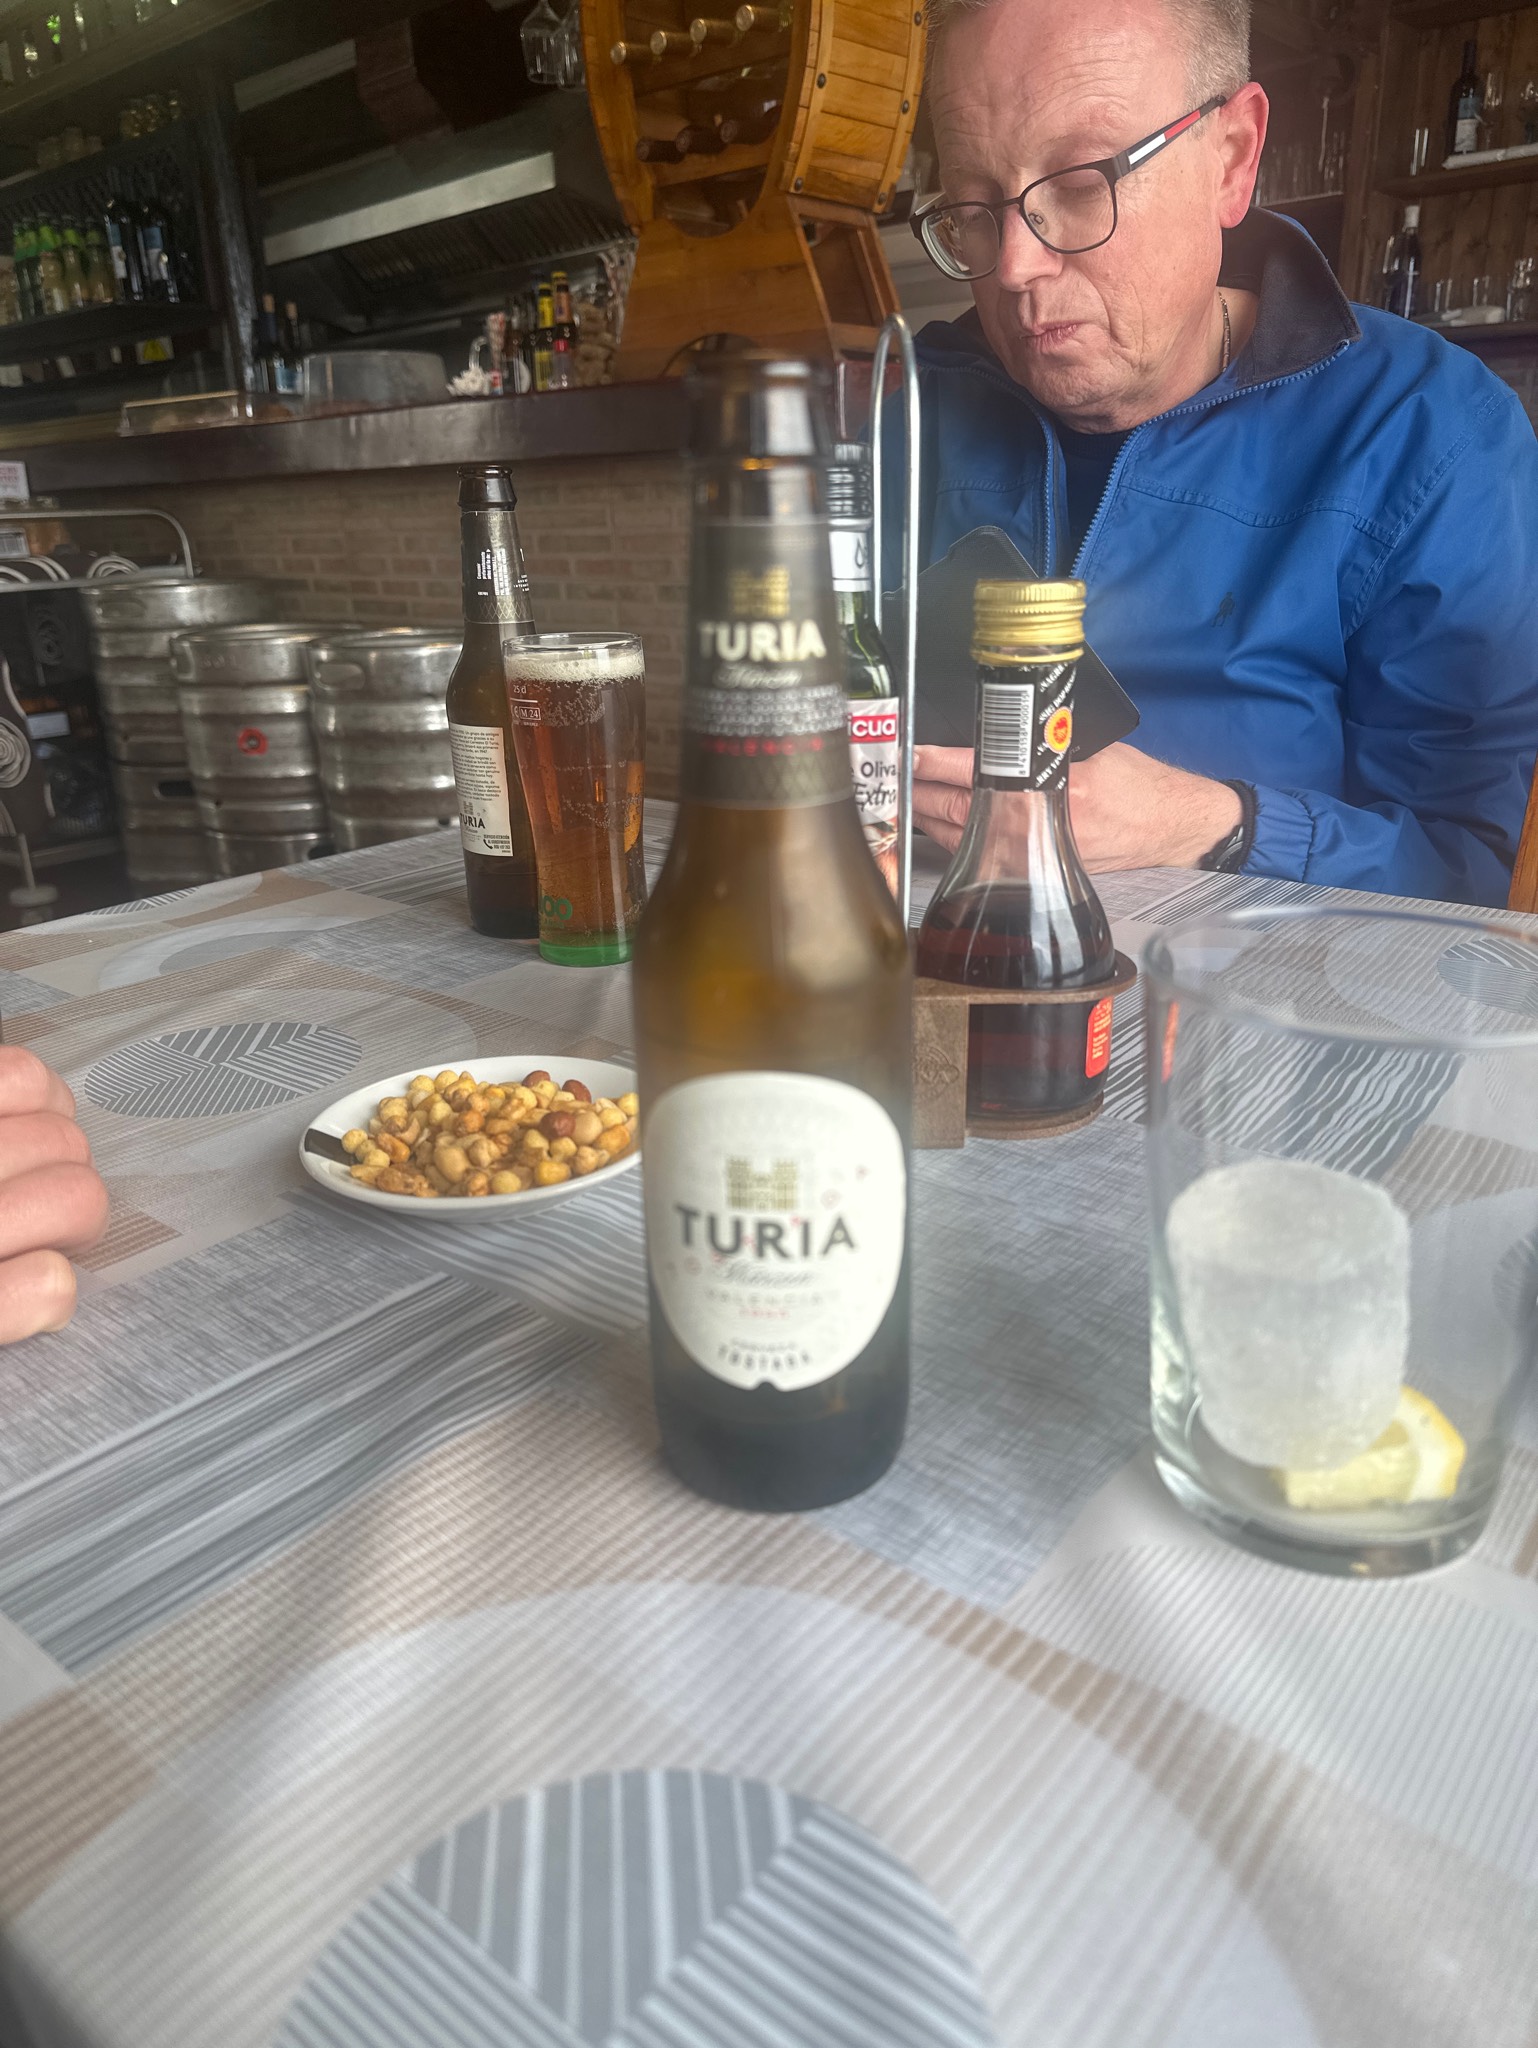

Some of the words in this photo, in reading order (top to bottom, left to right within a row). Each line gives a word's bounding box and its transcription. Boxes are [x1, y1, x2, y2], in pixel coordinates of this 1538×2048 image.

[698, 620, 827, 663] TURIA
[460, 813, 486, 828] TURIA
[672, 1202, 856, 1259] TURIA
